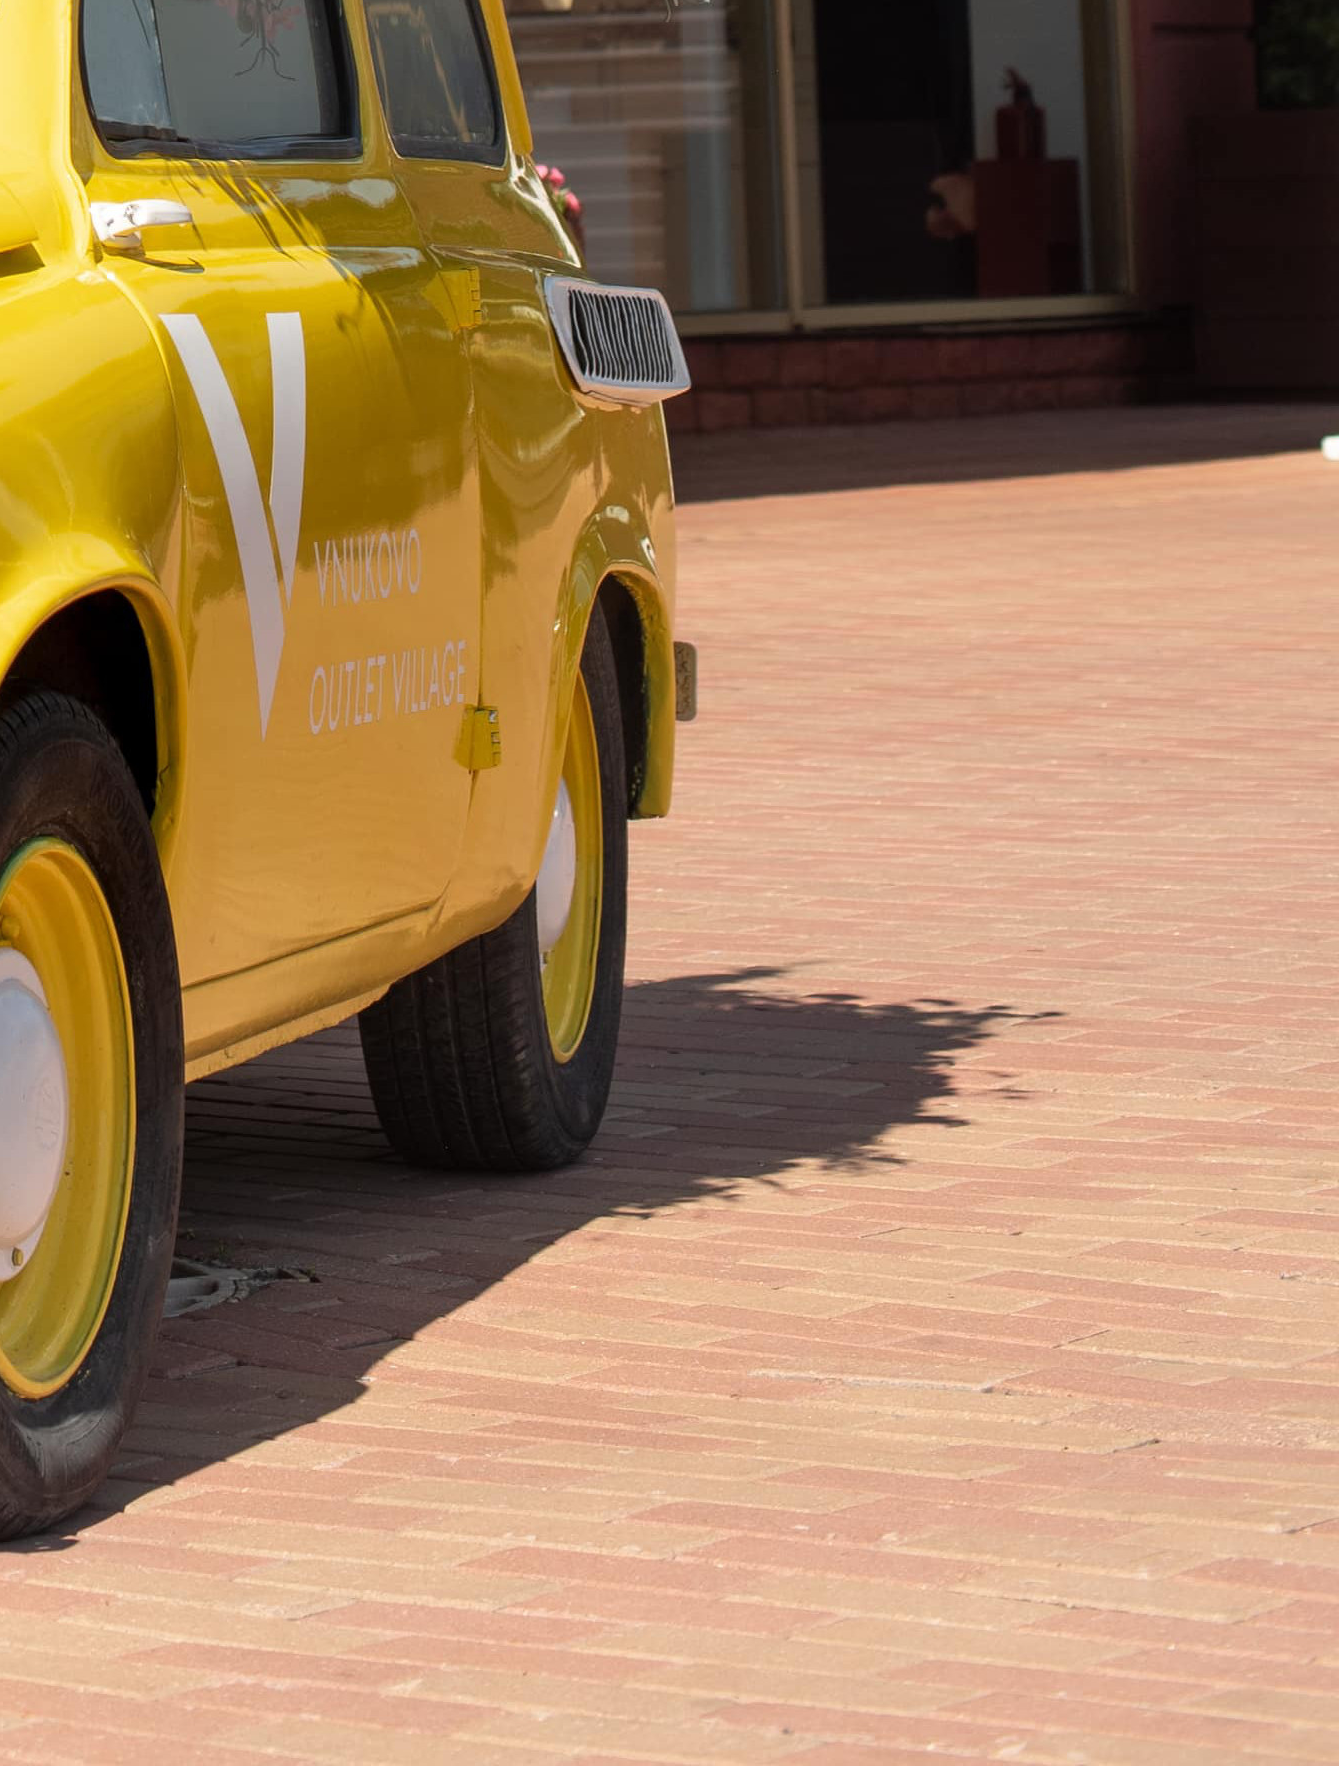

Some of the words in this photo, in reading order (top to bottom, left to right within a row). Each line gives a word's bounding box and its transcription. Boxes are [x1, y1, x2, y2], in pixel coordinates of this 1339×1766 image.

[313, 528, 423, 607] VNUKOVO
[309, 655, 386, 735] OUTLET
[393, 640, 468, 714] VILLAGE
